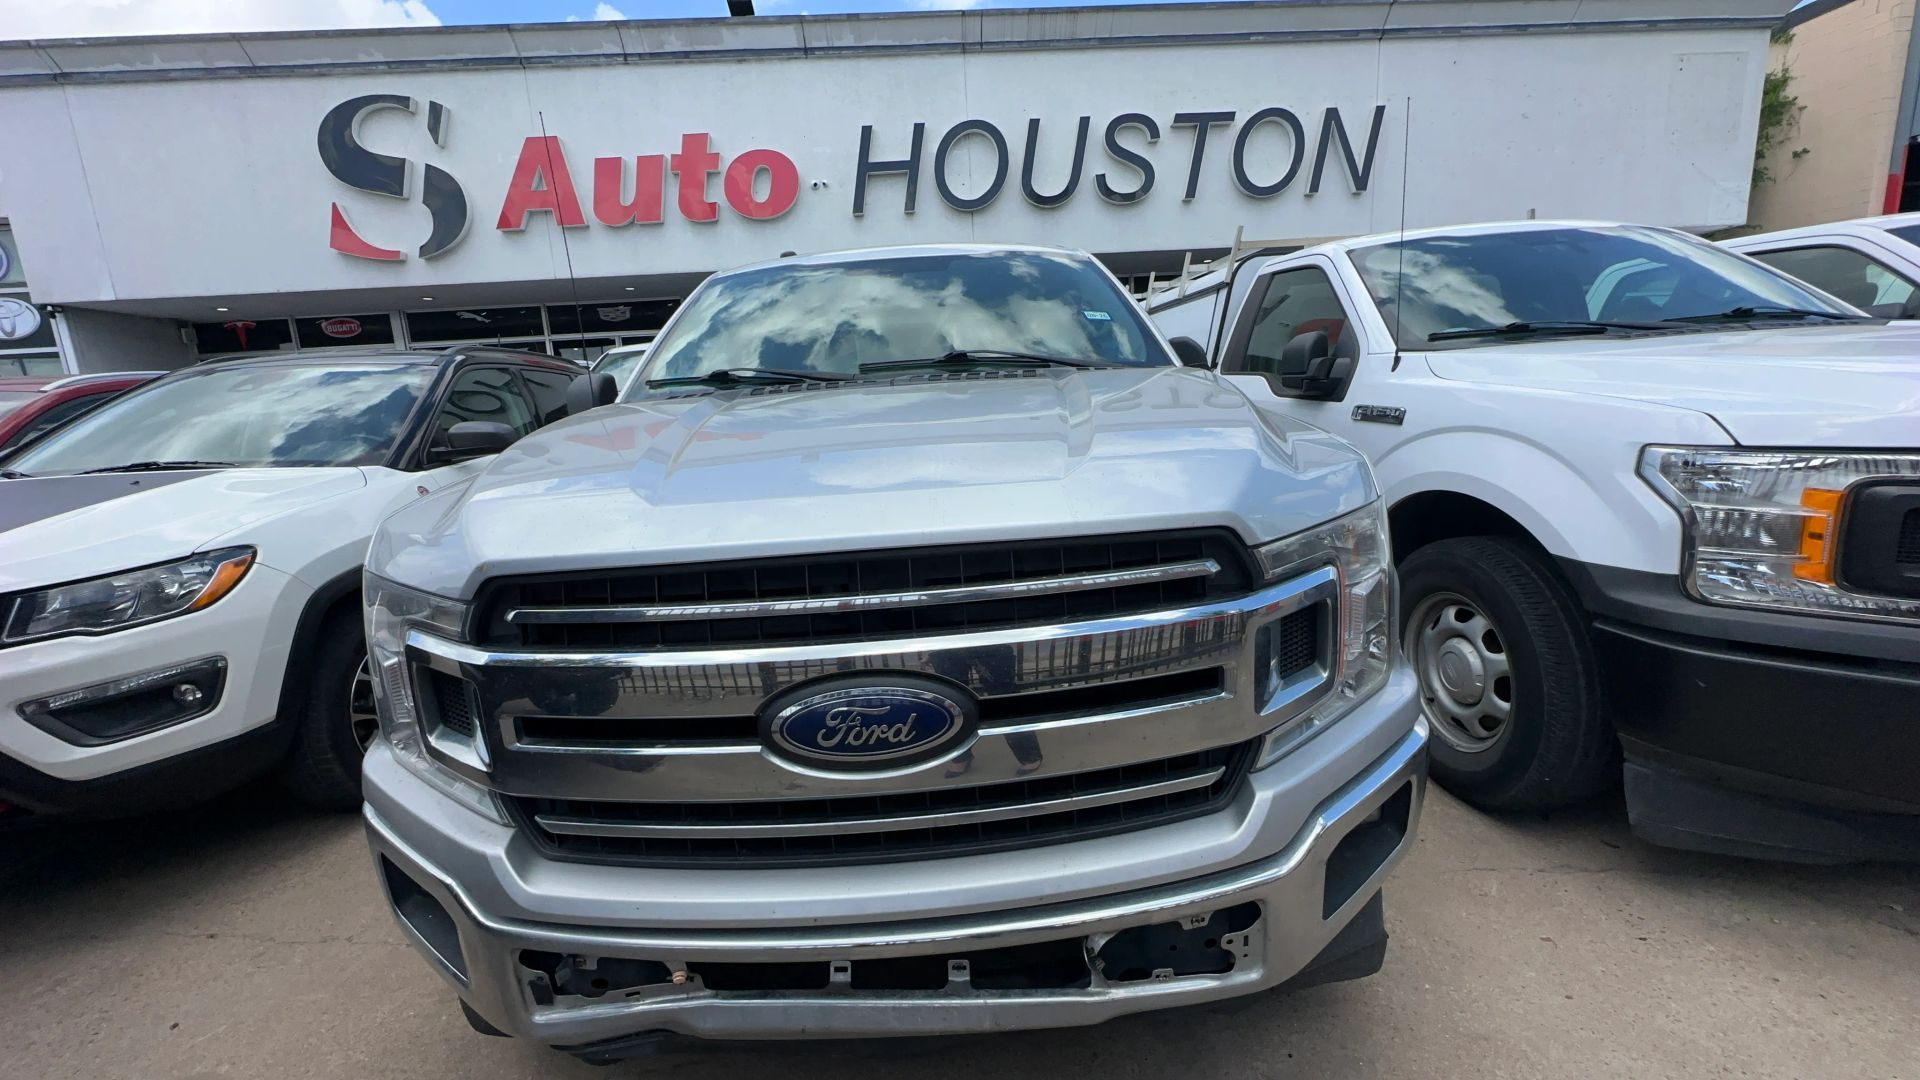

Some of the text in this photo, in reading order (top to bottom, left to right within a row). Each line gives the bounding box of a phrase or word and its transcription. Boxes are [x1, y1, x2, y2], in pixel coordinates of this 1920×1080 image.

[496, 131, 800, 233] Auto
[851, 104, 1386, 217] HOUSTON
[326, 323, 358, 333] BUGATTI
[816, 705, 917, 748] Ford
